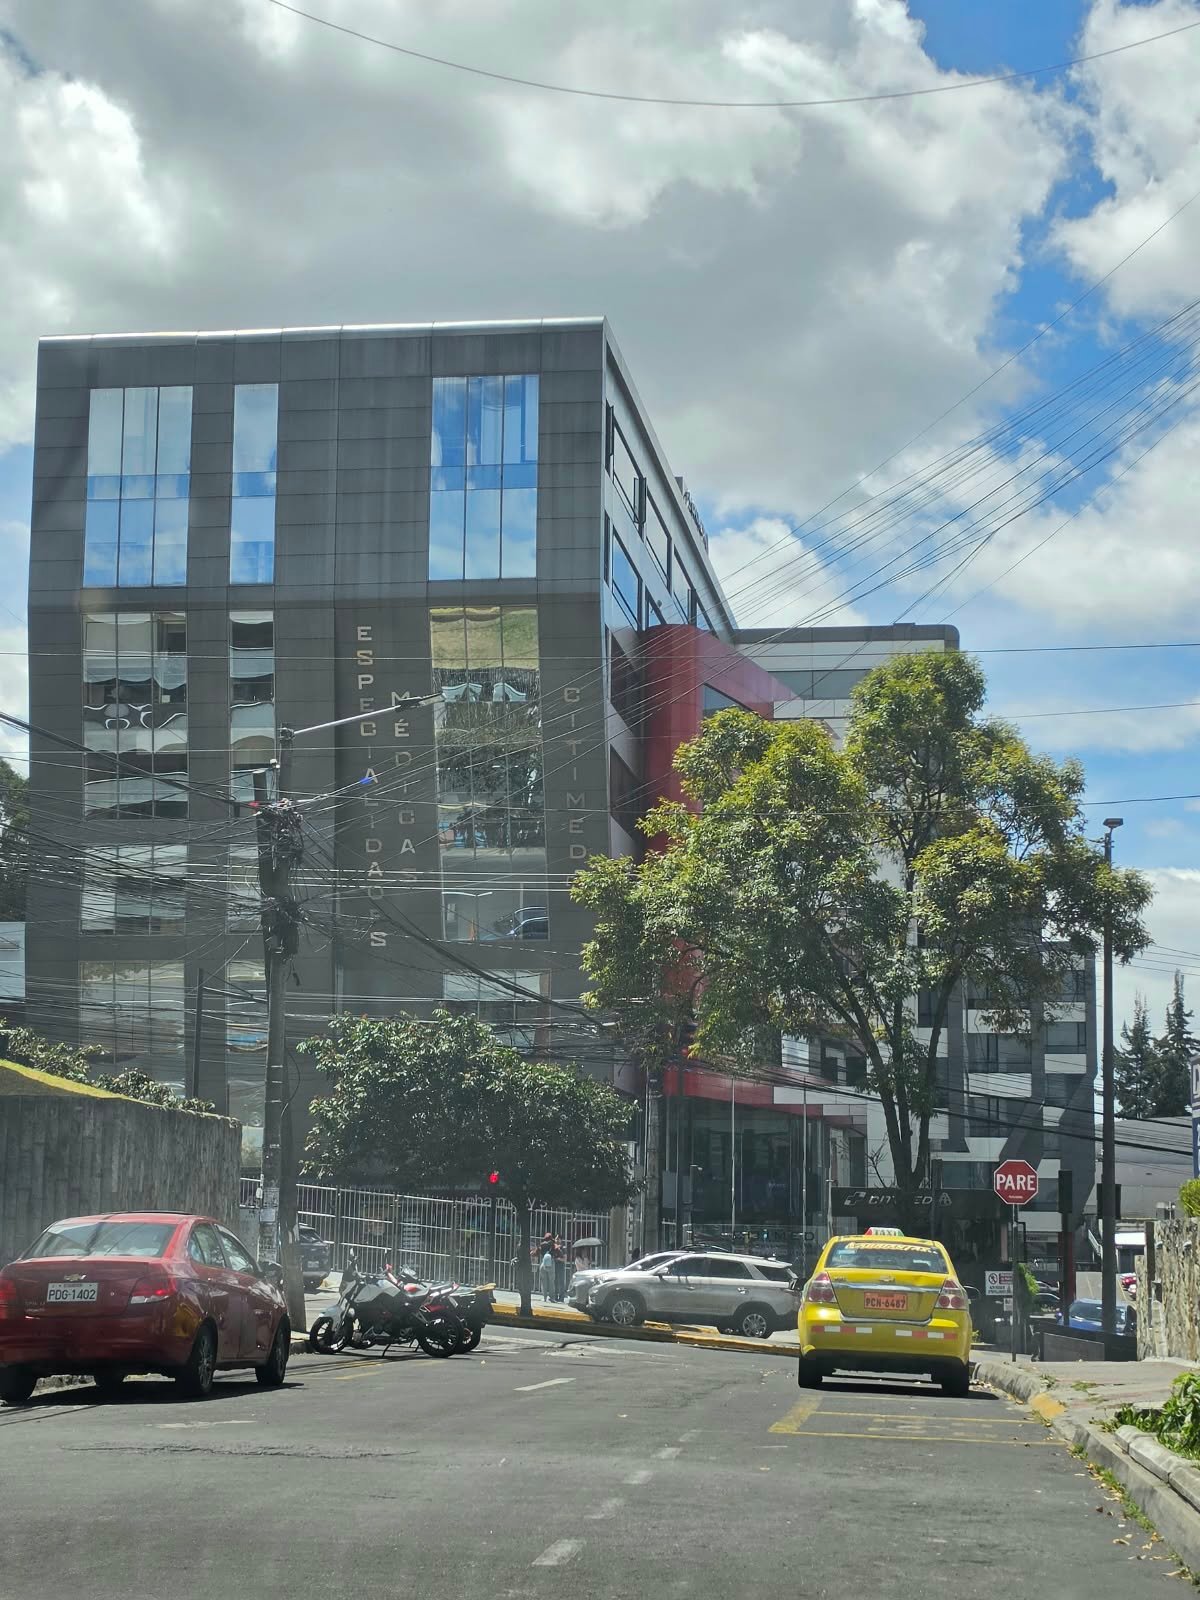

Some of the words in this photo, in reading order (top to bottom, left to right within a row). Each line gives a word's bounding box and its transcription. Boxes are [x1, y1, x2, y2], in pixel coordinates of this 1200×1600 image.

[996, 1173, 1036, 1191] PARE
[874, 1229, 897, 1237] TAXI
[48, 1289, 97, 1301] PDG-1402
